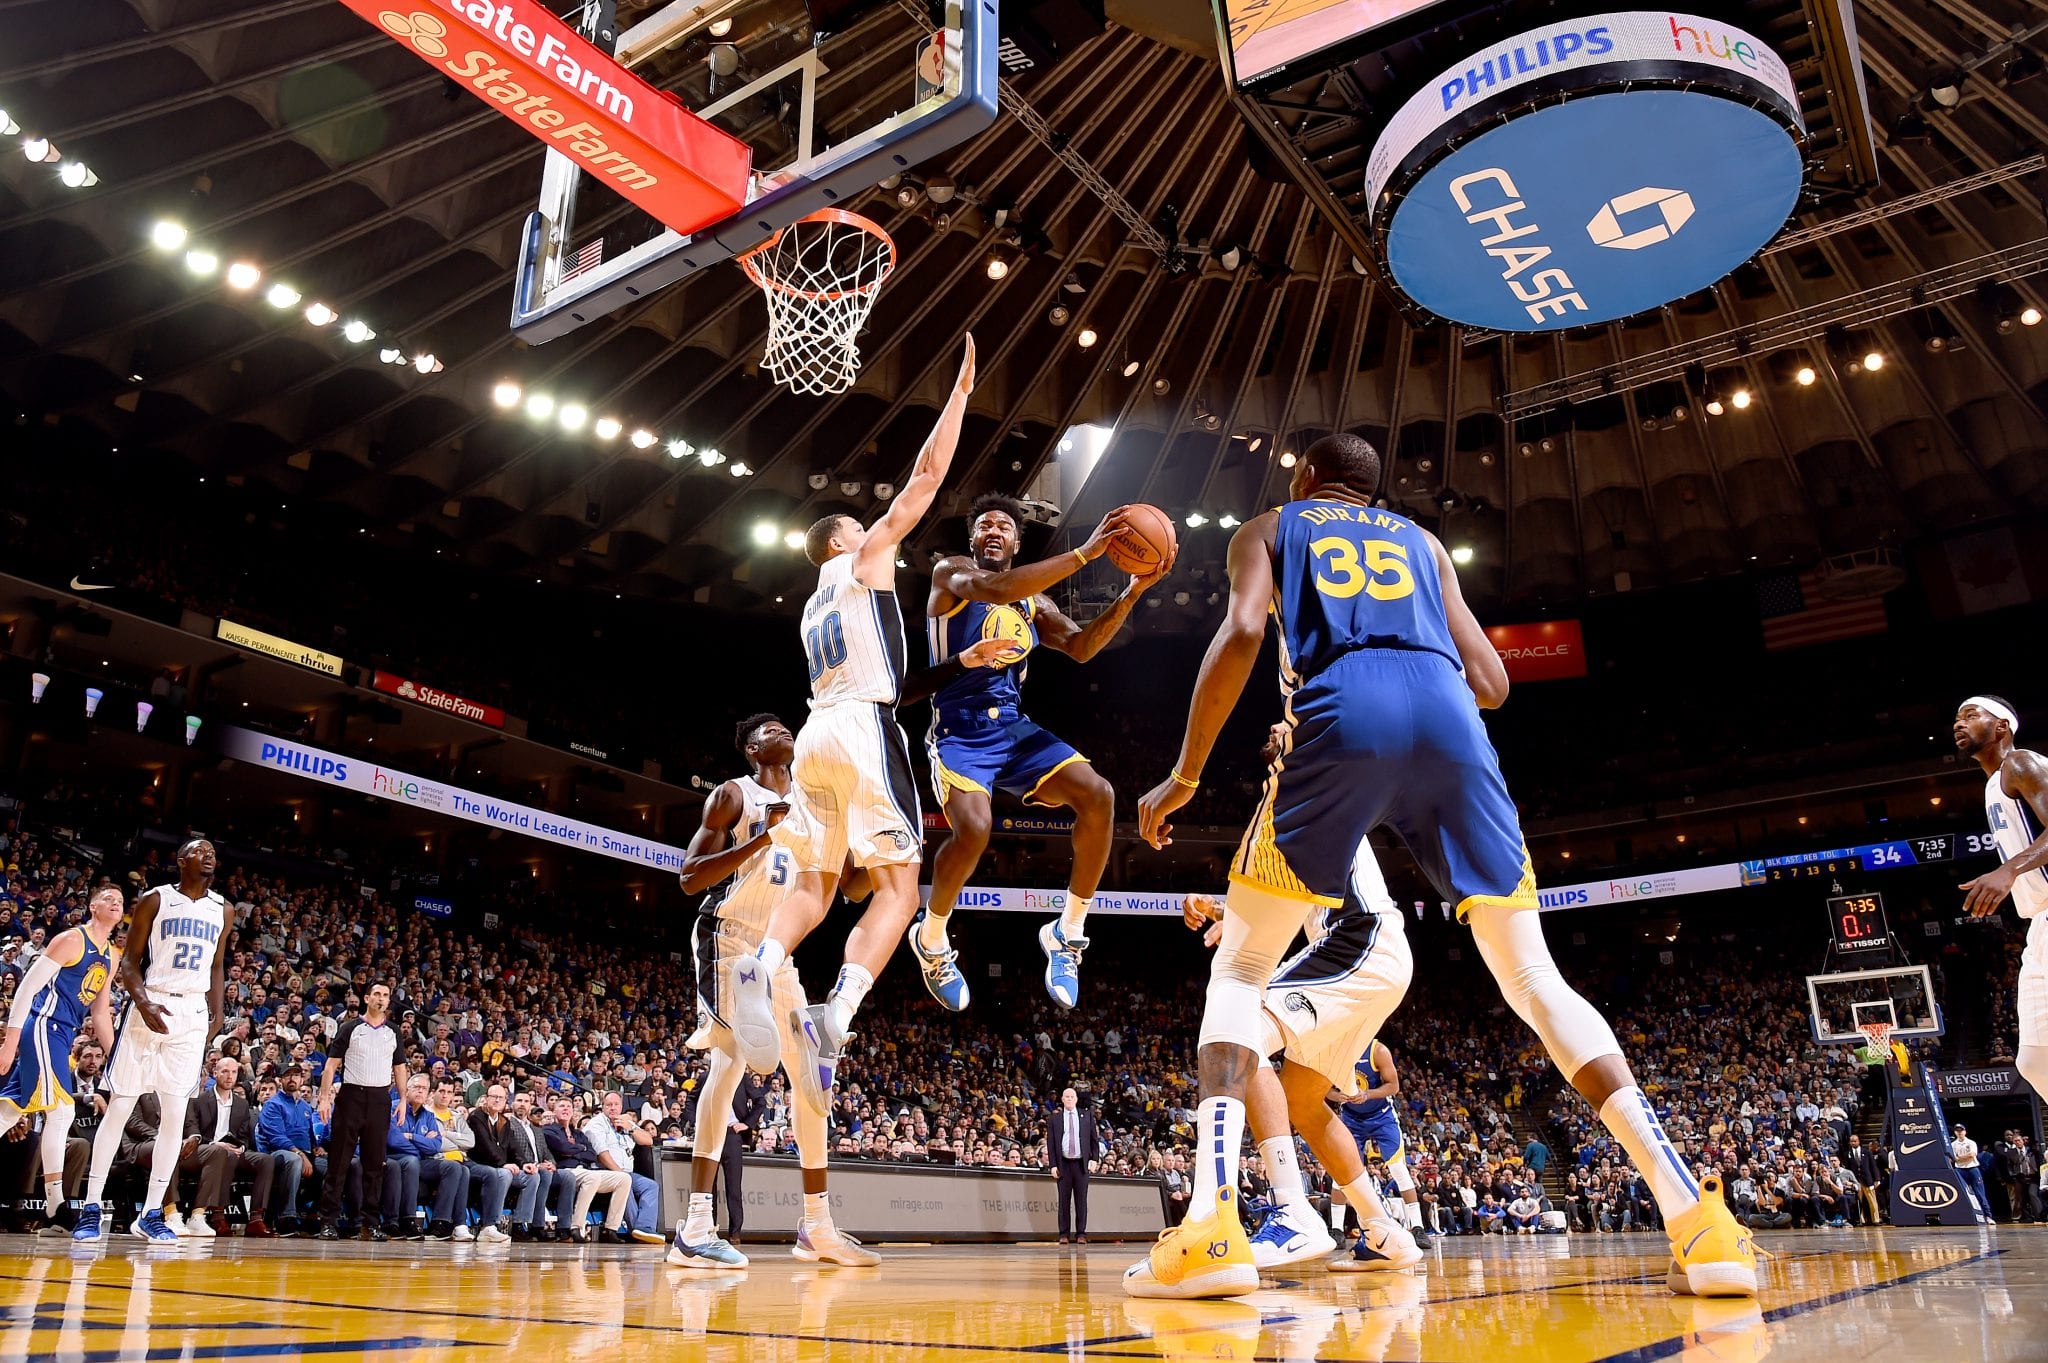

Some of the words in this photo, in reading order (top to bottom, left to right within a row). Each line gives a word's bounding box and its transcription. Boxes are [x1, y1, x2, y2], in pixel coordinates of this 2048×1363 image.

[1669, 16, 1757, 70] hue
[451, 0, 634, 123] ateFarm
[1441, 27, 1614, 111] PHILIPS
[1242, 65, 1286, 87] DAKTRONICS
[1449, 168, 1589, 324] CHASE
[1298, 506, 1407, 533] DURANT
[1309, 536, 1415, 601] 35
[807, 583, 836, 620] GORDON
[1014, 623, 1022, 637] 2
[225, 631, 249, 645] KAISER
[251, 640, 297, 661] PERMANENTE
[300, 652, 334, 673] thrive
[807, 611, 847, 683] 00
[1497, 644, 1568, 660] ORACLE
[570, 742, 607, 759] accenture
[261, 742, 347, 781] PHILIPS
[373, 767, 418, 800] hue
[453, 795, 481, 815] The
[485, 804, 529, 828] World
[534, 817, 581, 841] Leader
[586, 831, 598, 845] in
[602, 836, 641, 857] Smart
[645, 847, 684, 868] Lighti
[1015, 819, 1043, 830] GOLD
[1917, 838, 1946, 852] 7:35
[1966, 833, 1997, 853] 39
[1767, 857, 1781, 867] BLK
[1785, 856, 1799, 864] AST
[1803, 852, 1818, 862] REB
[1873, 846, 1902, 865] 34
[1926, 850, 1942, 860] 2nd
[771, 851, 788, 886] 5
[1773, 870, 1781, 880] 2
[1791, 867, 1798, 877] 7
[1806, 865, 1820, 876] 13
[1828, 863, 1836, 872] 6
[1848, 860, 1856, 870] 3
[958, 892, 1001, 907] ILIPS
[1024, 890, 1065, 908] hue
[1538, 889, 1588, 908] ILIPS
[1610, 881, 1652, 899] hue
[414, 900, 443, 913] CHASE
[1096, 897, 1121, 909] The
[1128, 898, 1168, 911] World
[1845, 898, 1876, 913] 7:35
[160, 917, 220, 945] MAGIC
[1852, 937, 1887, 949] TISSOT
[172, 942, 203, 972] 22
[1945, 1071, 2010, 1086] KEYSIGHT
[1947, 1083, 2011, 1094] TECHNOLOGIES
[1909, 1186, 1949, 1202] KIA
[890, 1197, 944, 1212] mirage.com
[983, 1200, 1001, 1212] THE
